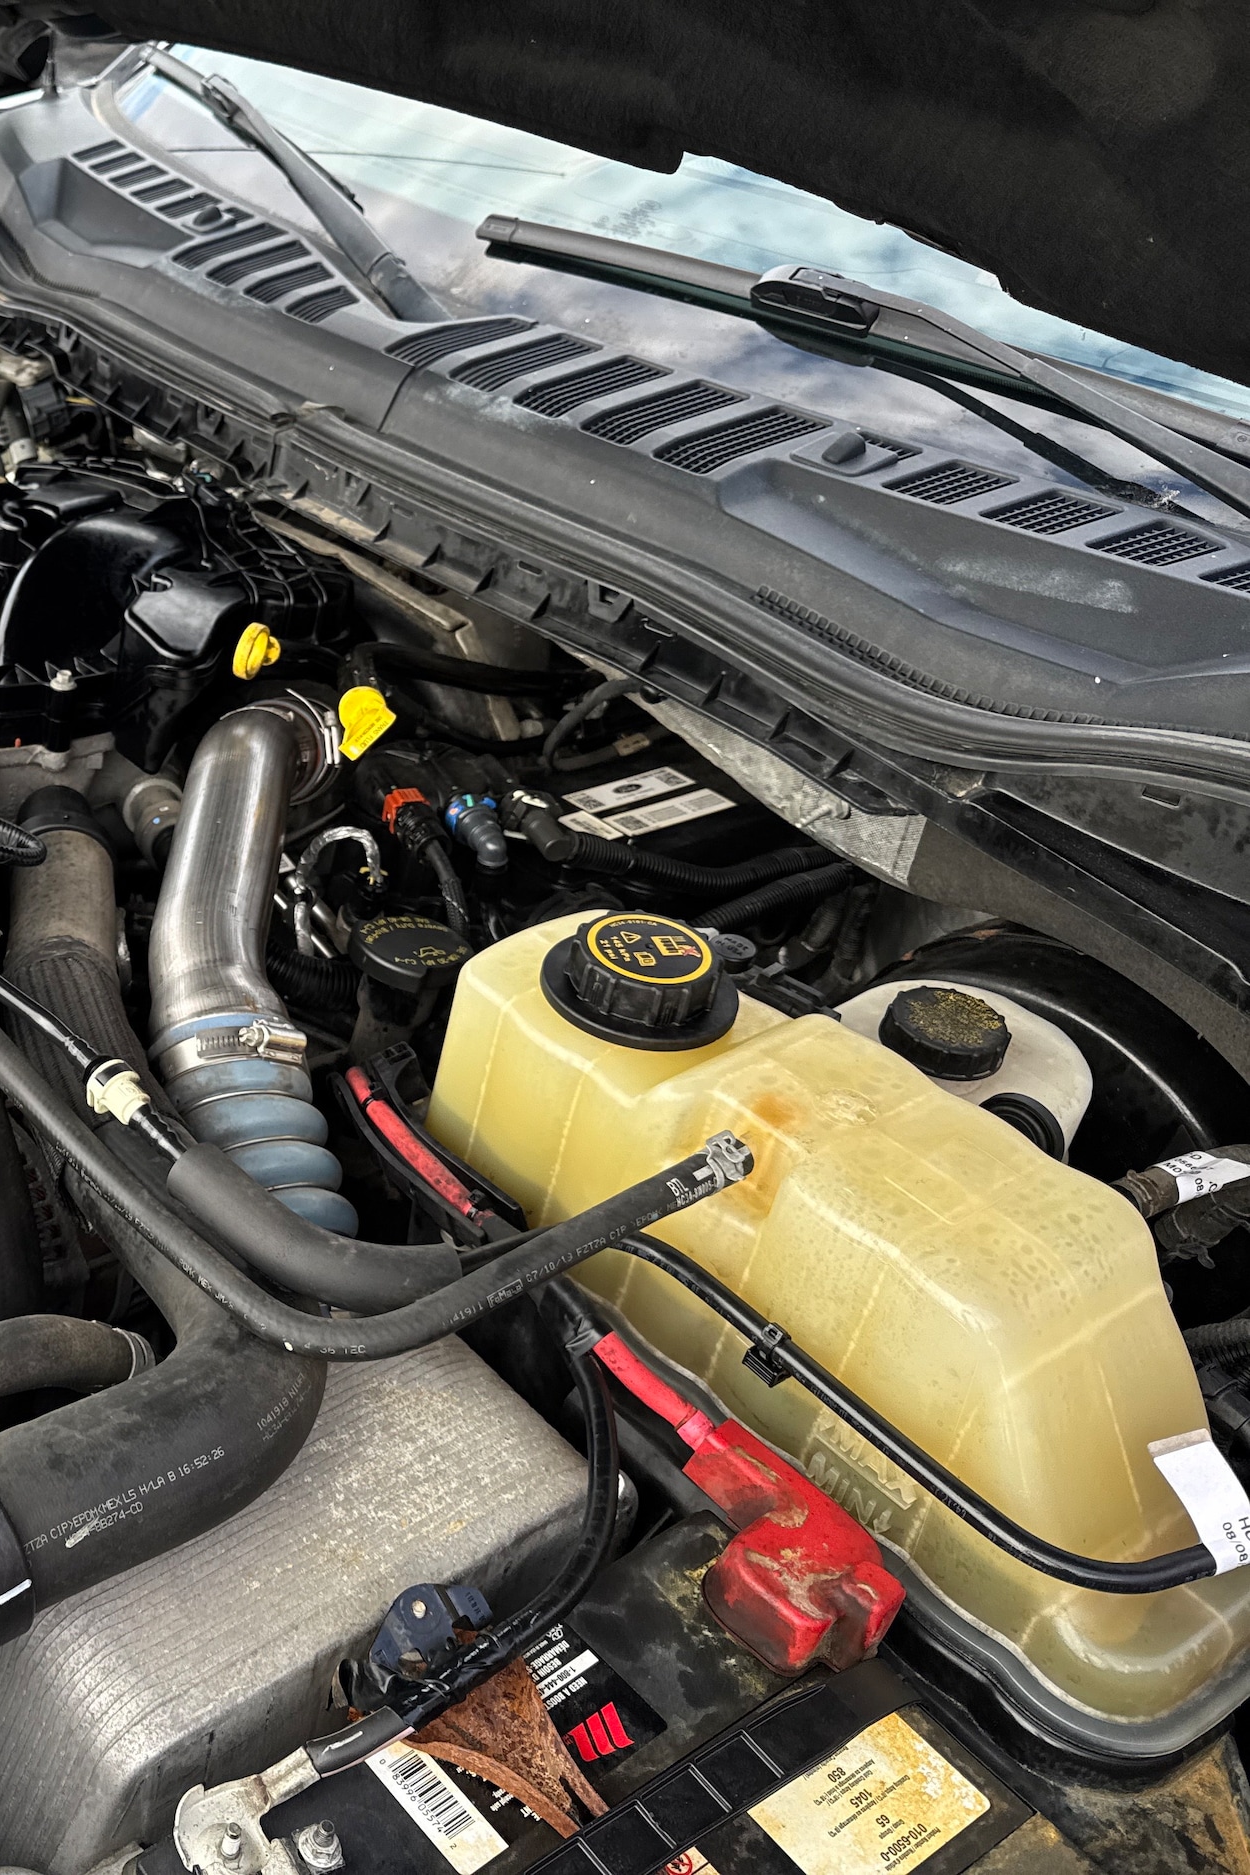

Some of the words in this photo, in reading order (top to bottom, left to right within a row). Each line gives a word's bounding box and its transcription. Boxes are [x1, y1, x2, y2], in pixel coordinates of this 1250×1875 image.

[665, 1174, 689, 1198] BTL
[176, 1445, 226, 1476] 16:52:26
[805, 1451, 877, 1525] MIN
[536, 1656, 561, 1678] BESOIN
[561, 1687, 571, 1697] A
[567, 1675, 587, 1693] NEED
[826, 1765, 846, 1784] 850
[391, 1772, 418, 1802] 83996
[416, 1802, 444, 1833] 05574
[848, 1786, 873, 1809] 1045
[874, 1813, 890, 1828] 65
[878, 1822, 928, 1863] 010-6500-0
